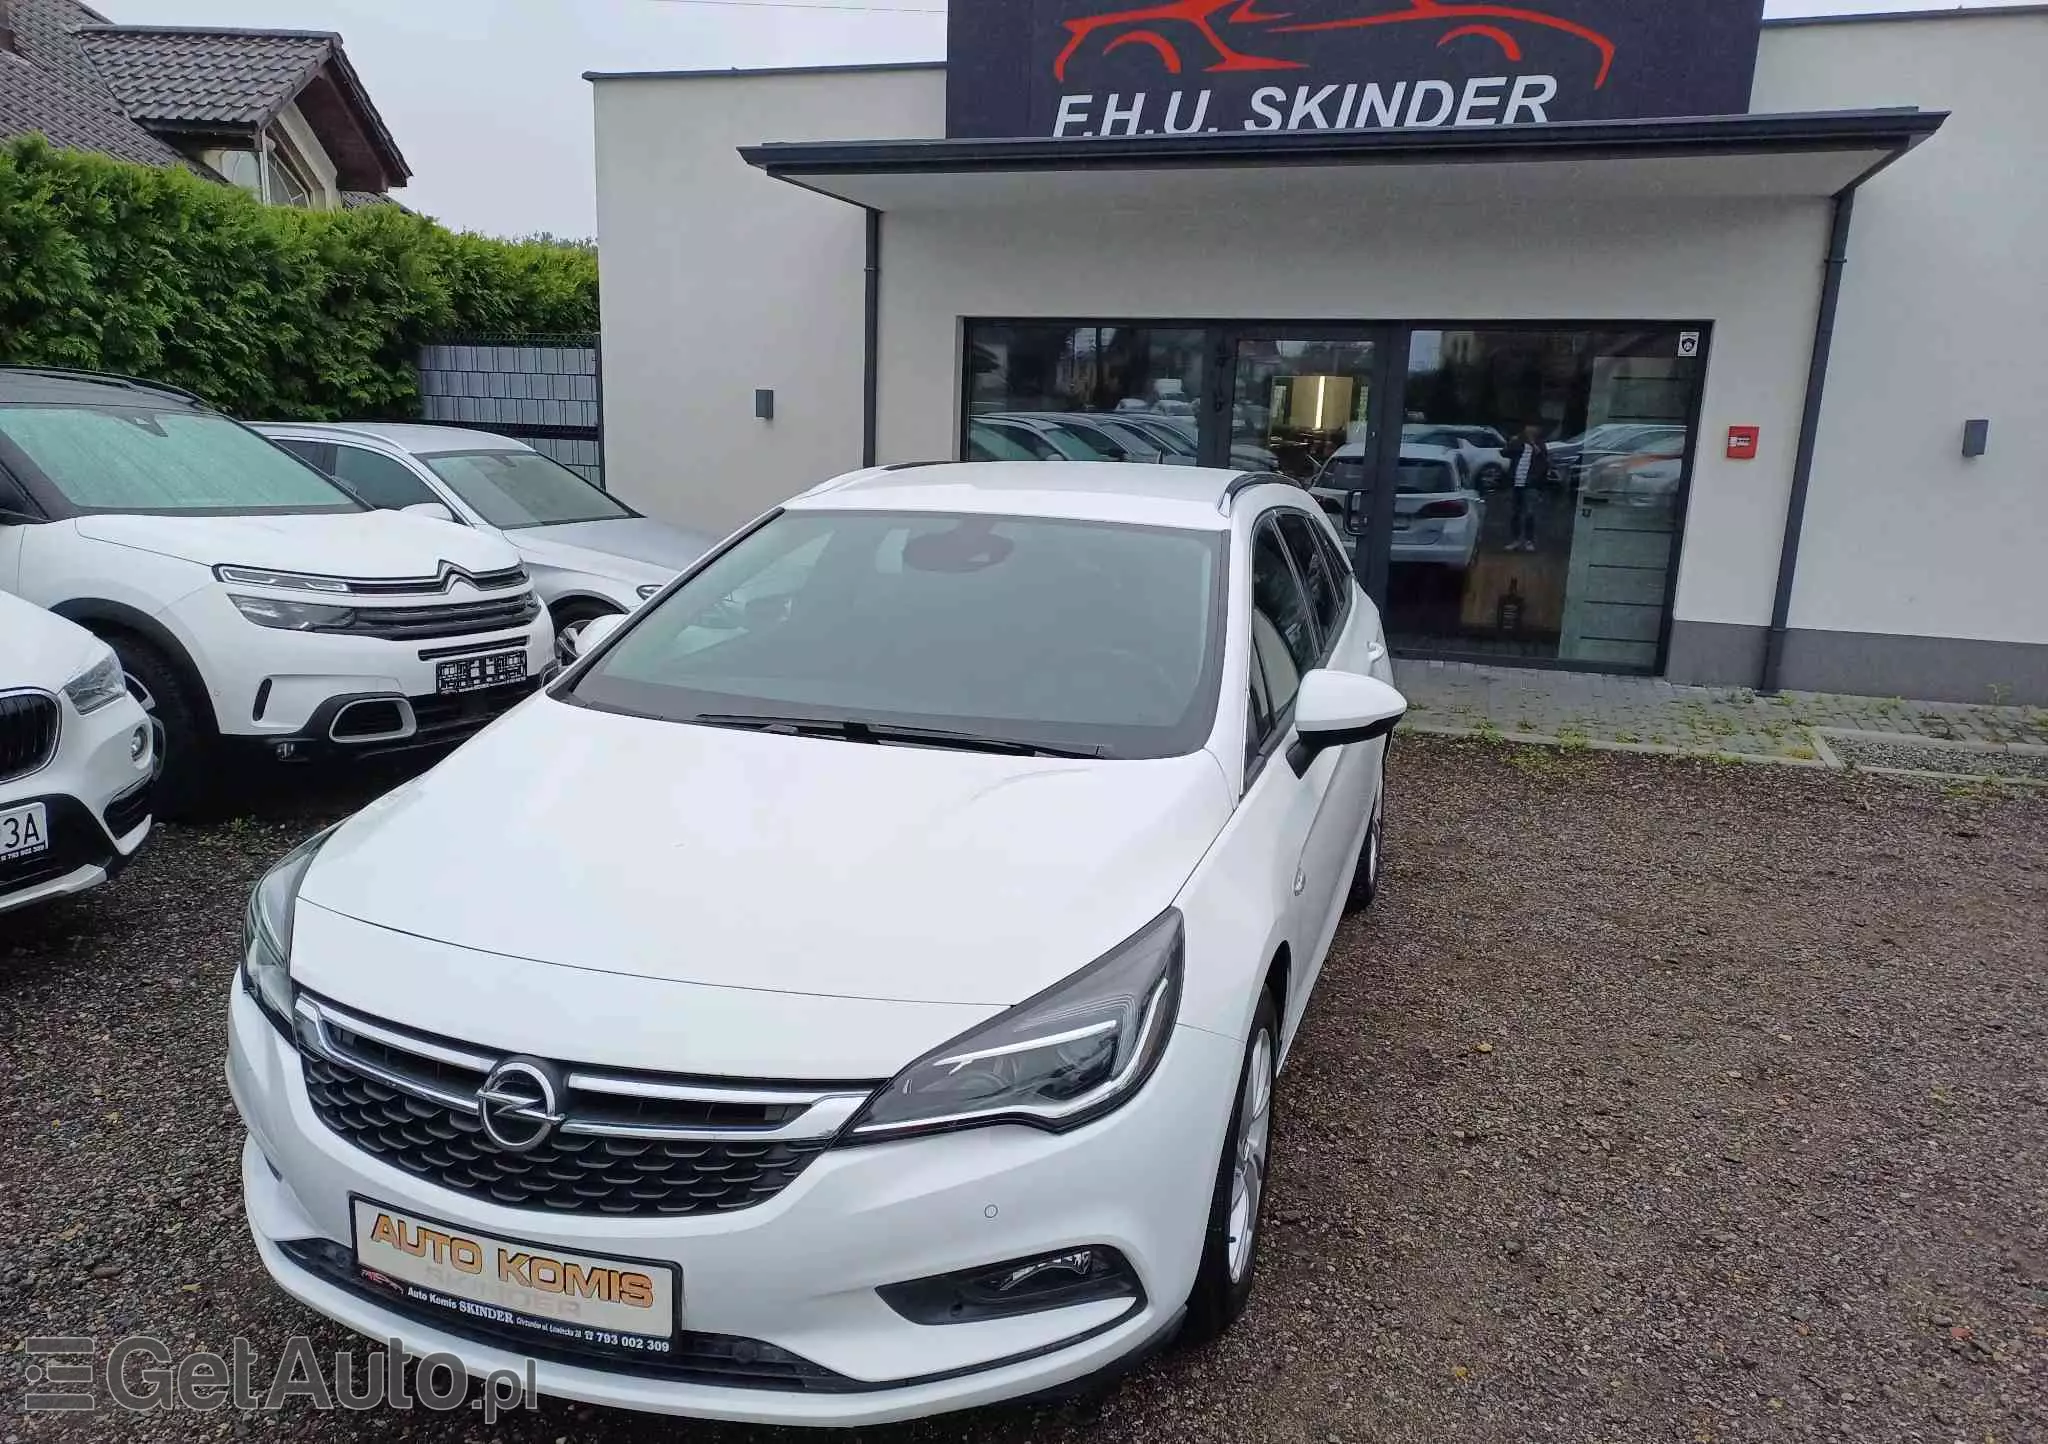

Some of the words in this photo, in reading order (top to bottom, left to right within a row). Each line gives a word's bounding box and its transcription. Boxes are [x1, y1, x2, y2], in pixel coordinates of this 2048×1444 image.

[1053, 89, 1218, 138] F.H.U.
[1244, 75, 1558, 131] SKINDER
[369, 1212, 484, 1275] AUTO
[497, 1247, 654, 1309] KOMIS
[407, 1287, 428, 1301] Auto
[429, 1293, 457, 1309] Komis
[459, 1301, 514, 1325] SKINDER
[596, 1332, 618, 1345] 793
[621, 1337, 643, 1349] 002
